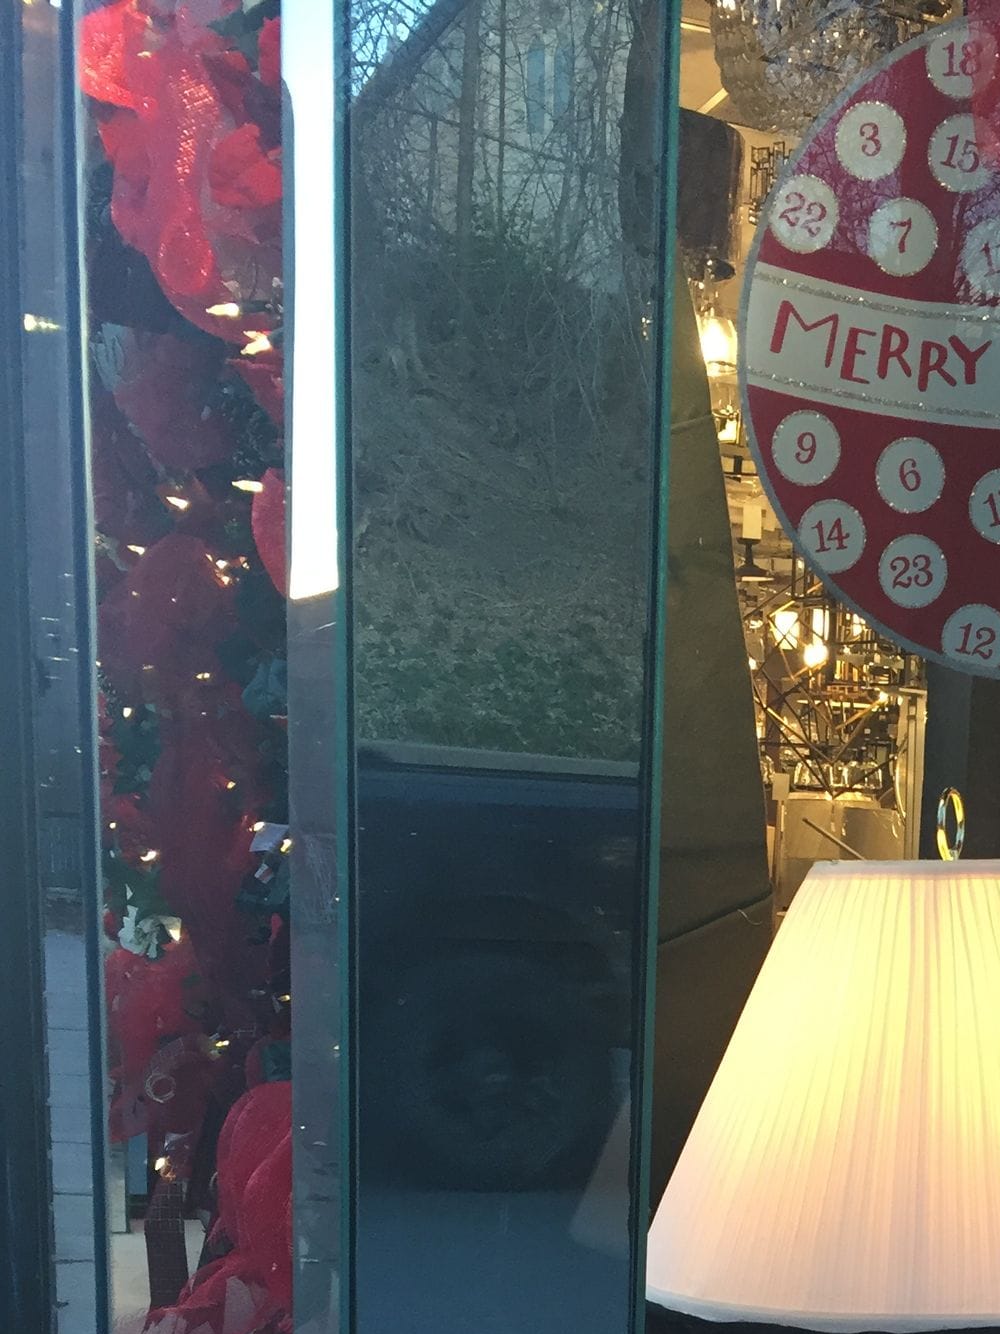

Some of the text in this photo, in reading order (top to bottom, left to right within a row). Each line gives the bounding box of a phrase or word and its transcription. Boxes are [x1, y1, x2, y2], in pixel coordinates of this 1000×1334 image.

[941, 42, 979, 78] 18
[860, 122, 883, 158] 3
[940, 135, 981, 174] 15
[780, 191, 828, 236] 22
[891, 218, 913, 255] 7
[770, 300, 993, 392] MERRY
[795, 431, 818, 464] 9
[898, 458, 923, 492] 6
[812, 517, 850, 553] 14
[890, 555, 934, 589] 23
[955, 623, 994, 658] 12
